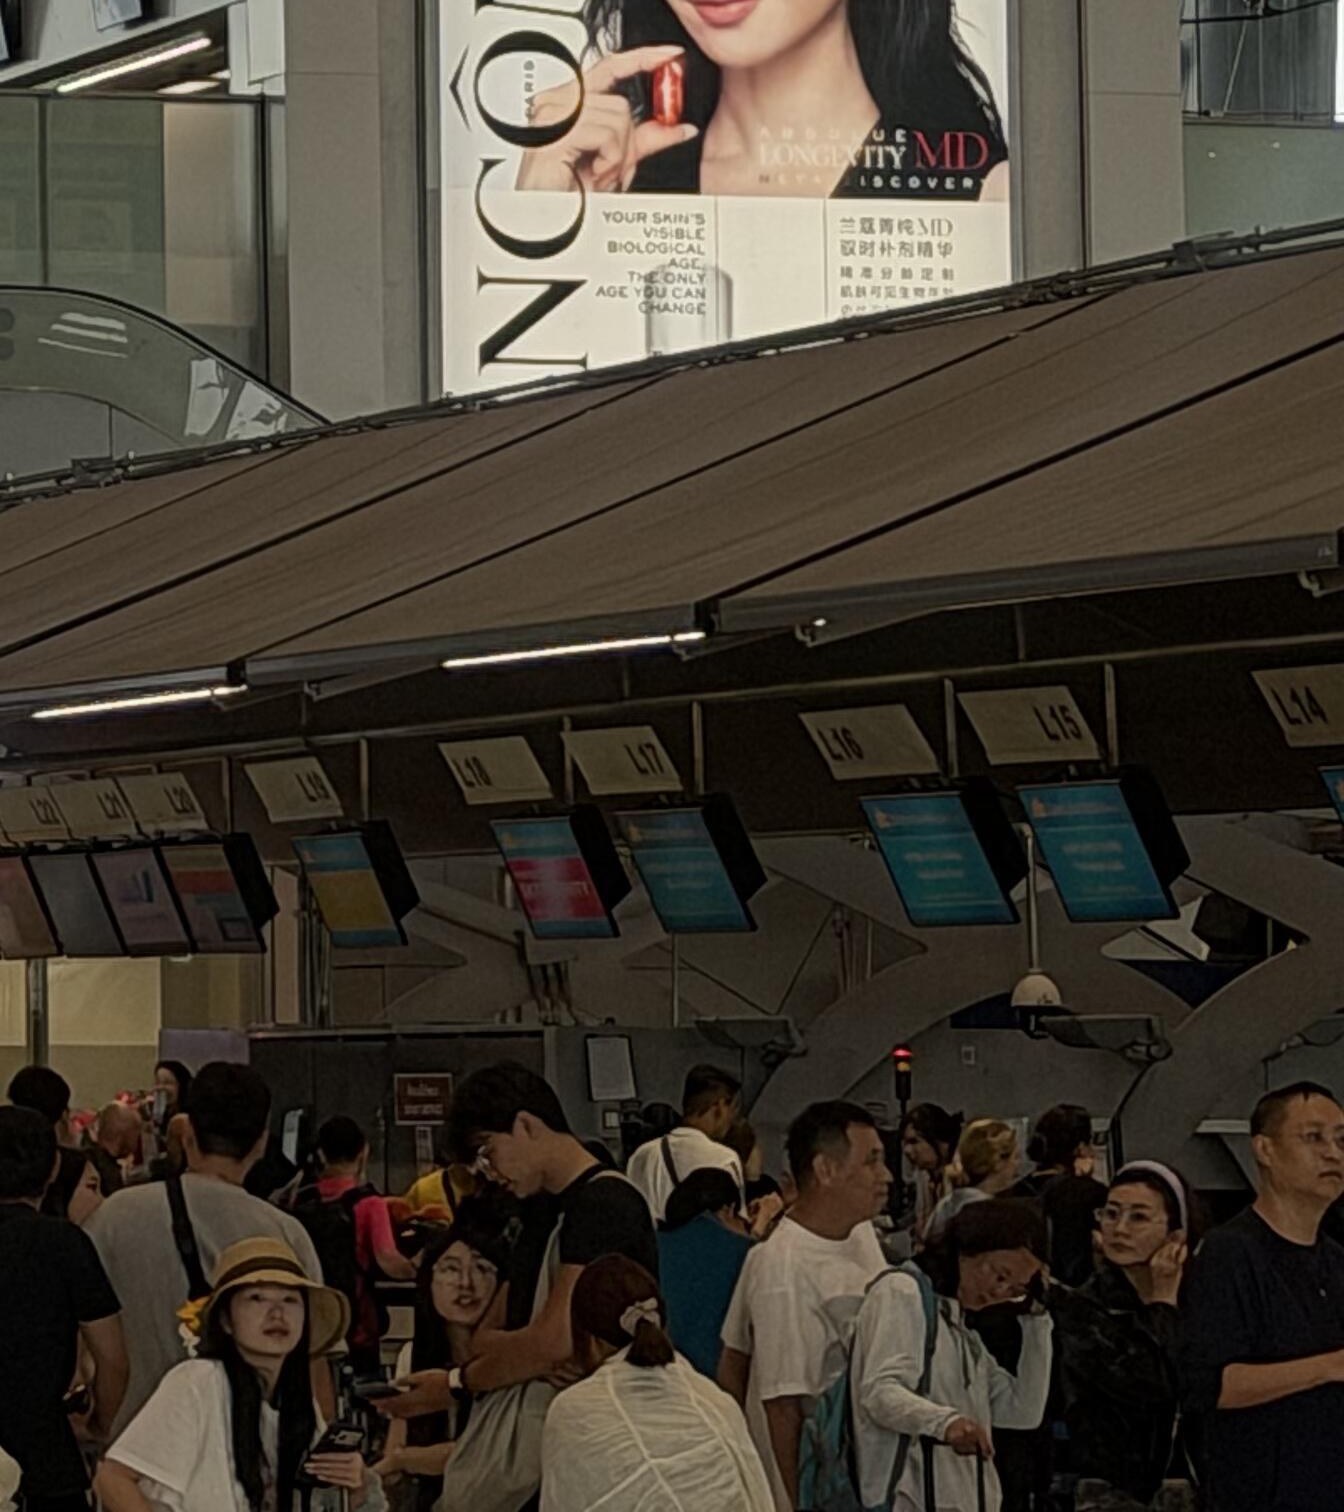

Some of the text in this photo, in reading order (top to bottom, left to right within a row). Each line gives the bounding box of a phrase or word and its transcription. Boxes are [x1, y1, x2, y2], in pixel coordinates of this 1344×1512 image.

[913, 131, 989, 170] MD
[602, 211, 647, 224] YOUR
[643, 227, 706, 241] VISIBLE
[607, 241, 706, 256] BIOLOGICAL
[628, 271, 706, 285] THE ONLY
[596, 285, 706, 299] AGE YOU CAN
[638, 301, 706, 315] CHANGE
[1270, 684, 1329, 725] L14
[1032, 704, 1085, 742] L15
[817, 727, 865, 763] L16
[625, 742, 667, 775] L17
